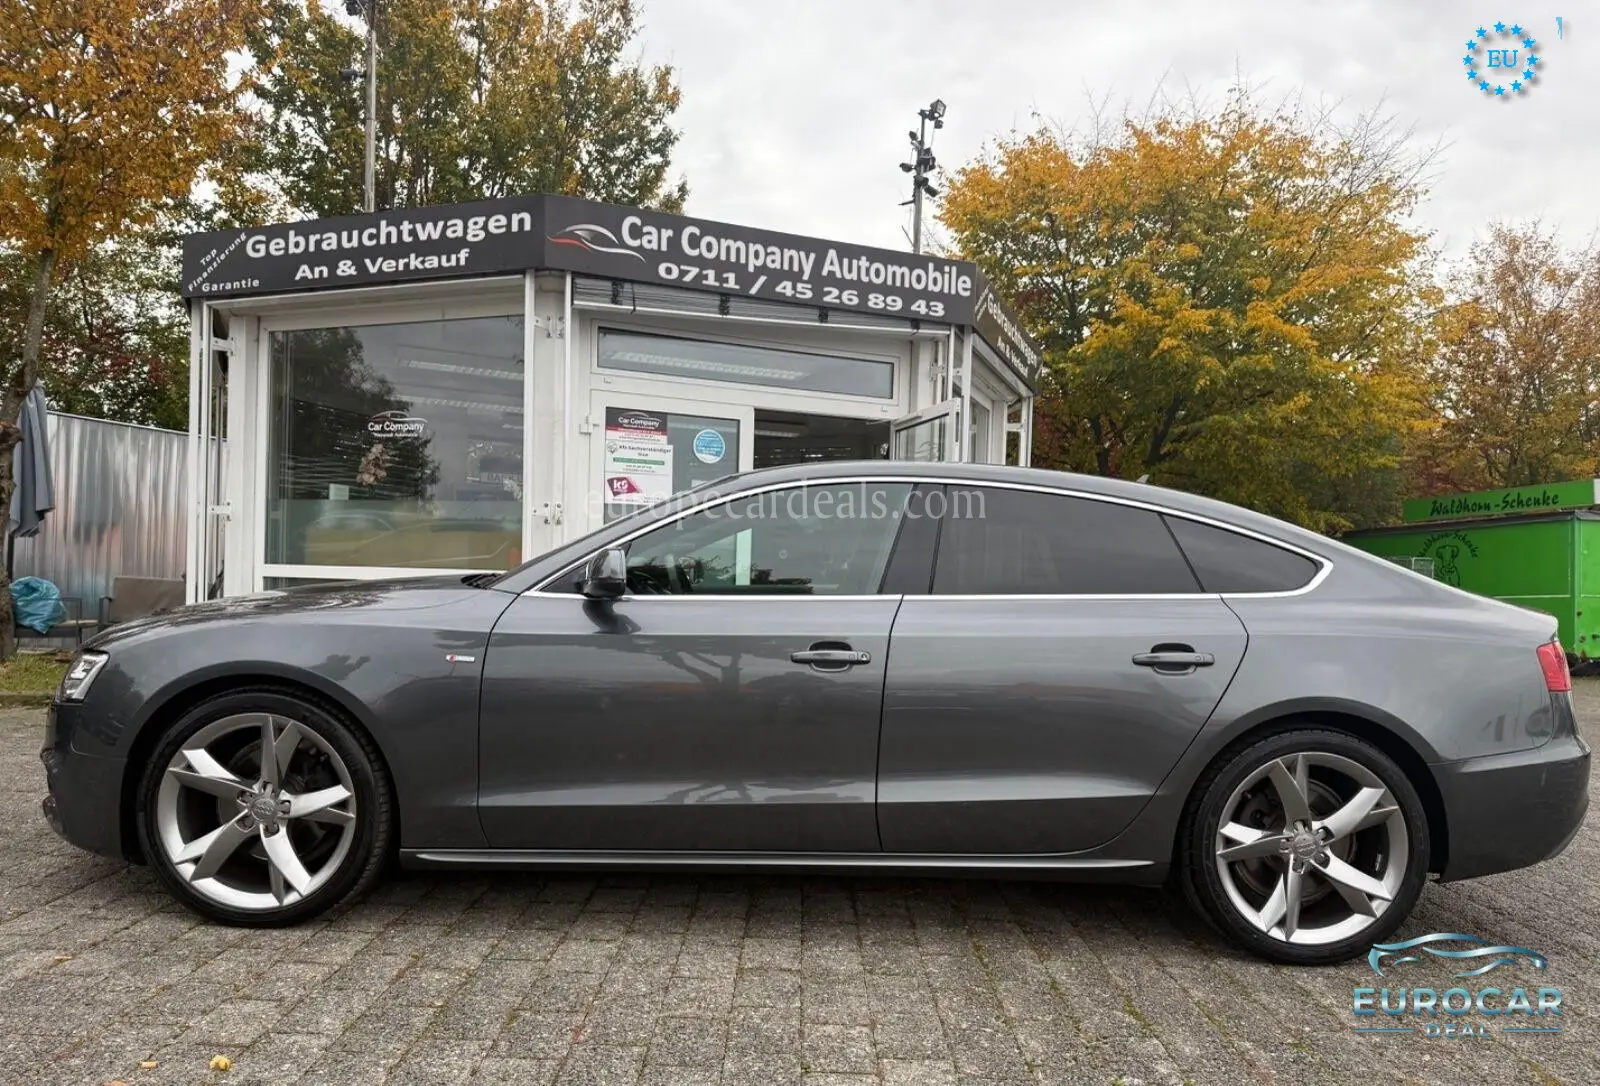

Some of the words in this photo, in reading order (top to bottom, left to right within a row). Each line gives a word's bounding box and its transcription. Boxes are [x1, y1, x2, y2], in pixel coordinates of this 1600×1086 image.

[246, 211, 532, 259] Gebrauchtwagen
[200, 248, 217, 266] Top
[295, 263, 328, 281] An
[336, 259, 357, 277] &
[364, 248, 471, 275] Verkauf
[621, 215, 674, 252] Car
[681, 225, 816, 281] Company
[821, 248, 972, 297] Automobile
[202, 278, 260, 292] Garantie
[658, 262, 741, 290] 0711
[749, 275, 768, 296] /
[775, 280, 814, 300] 45
[822, 286, 860, 306] 26
[867, 292, 903, 312] 89
[910, 299, 945, 318] 43
[367, 422, 382, 431] Car
[383, 421, 424, 432] Company
